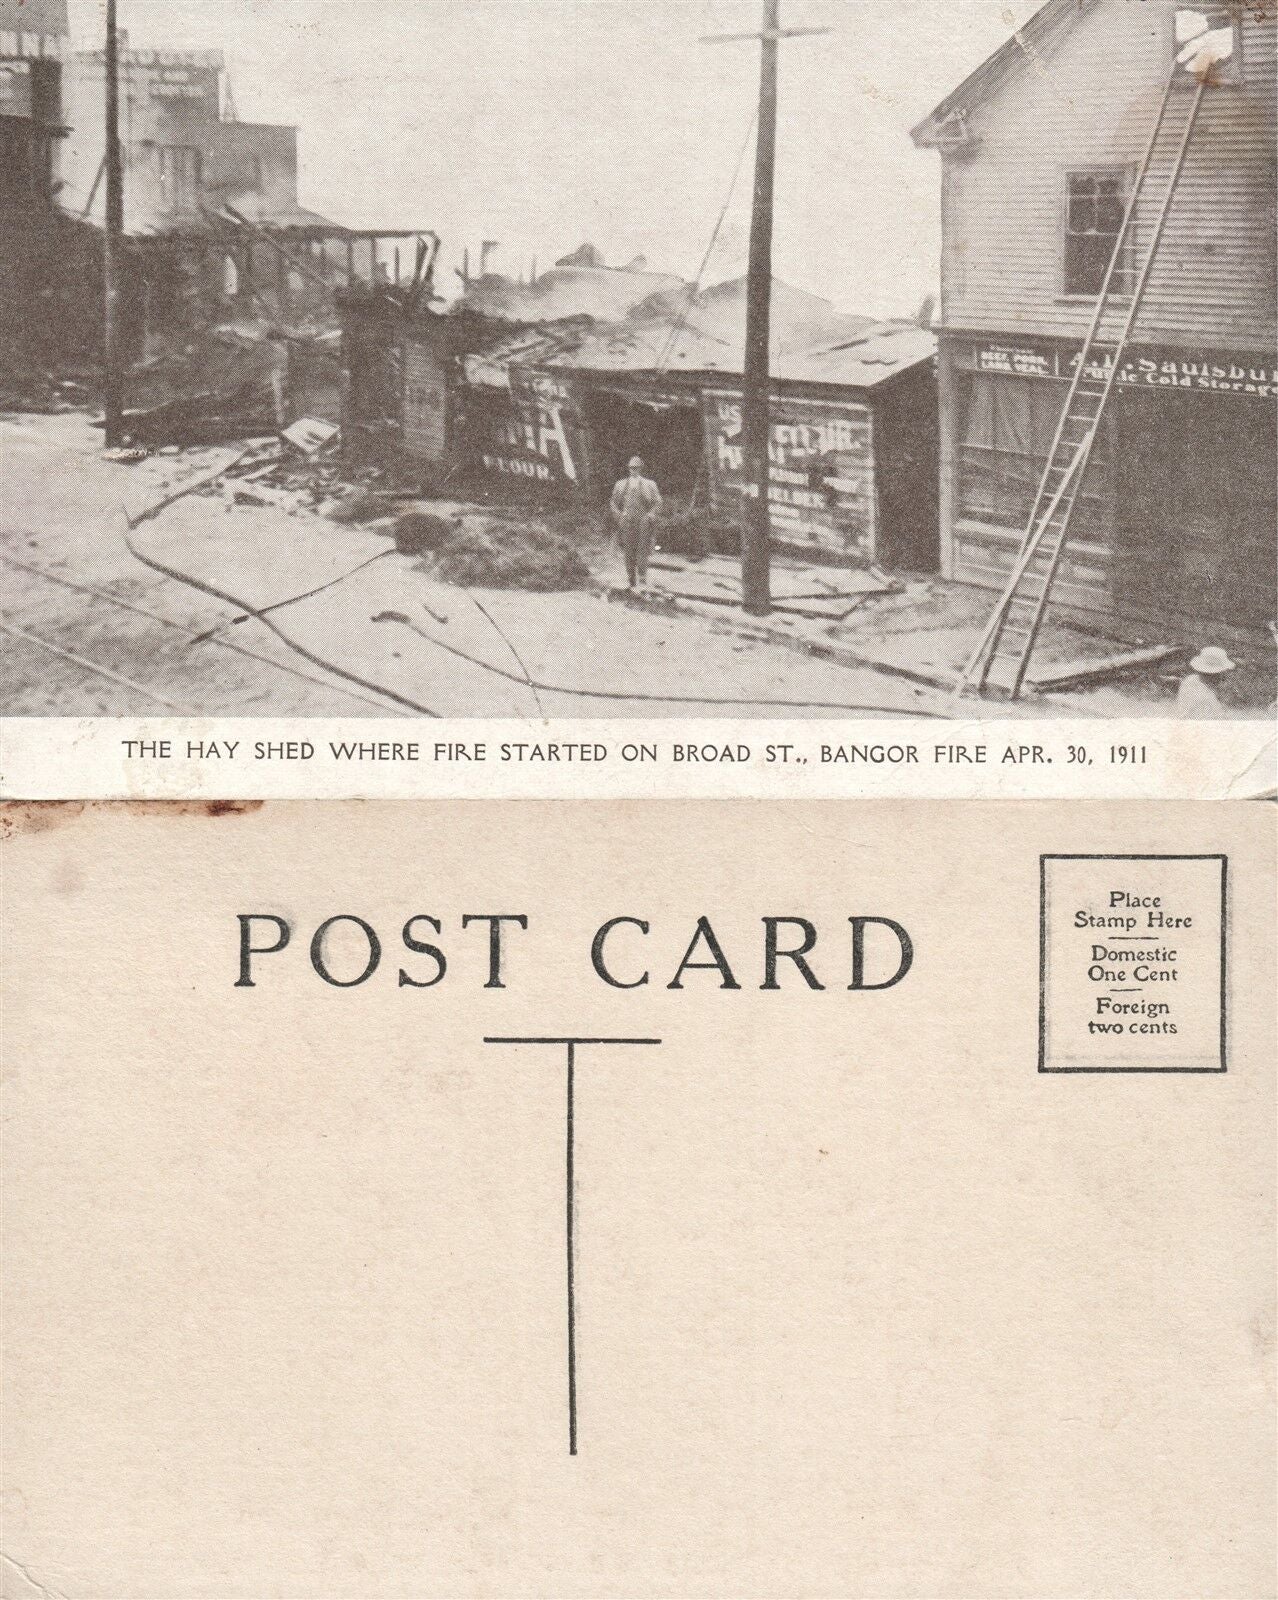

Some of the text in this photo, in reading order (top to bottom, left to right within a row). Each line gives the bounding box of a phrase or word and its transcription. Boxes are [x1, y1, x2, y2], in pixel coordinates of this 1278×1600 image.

[1146, 373, 1191, 387] Cold
[122, 741, 1147, 765] THE HAY SHED WHERE FIRE STARTED ON BROAD ST., BANGOR FIRE APR. 30, 1911
[1109, 891, 1161, 908] Place
[1074, 911, 1192, 931] Stamp Here
[234, 915, 913, 990] POST CARD
[1091, 945, 1177, 961] Domestic
[1087, 965, 1178, 981] One Cent
[1096, 997, 1170, 1018] Foreign
[1087, 1020, 1178, 1034] two cents
